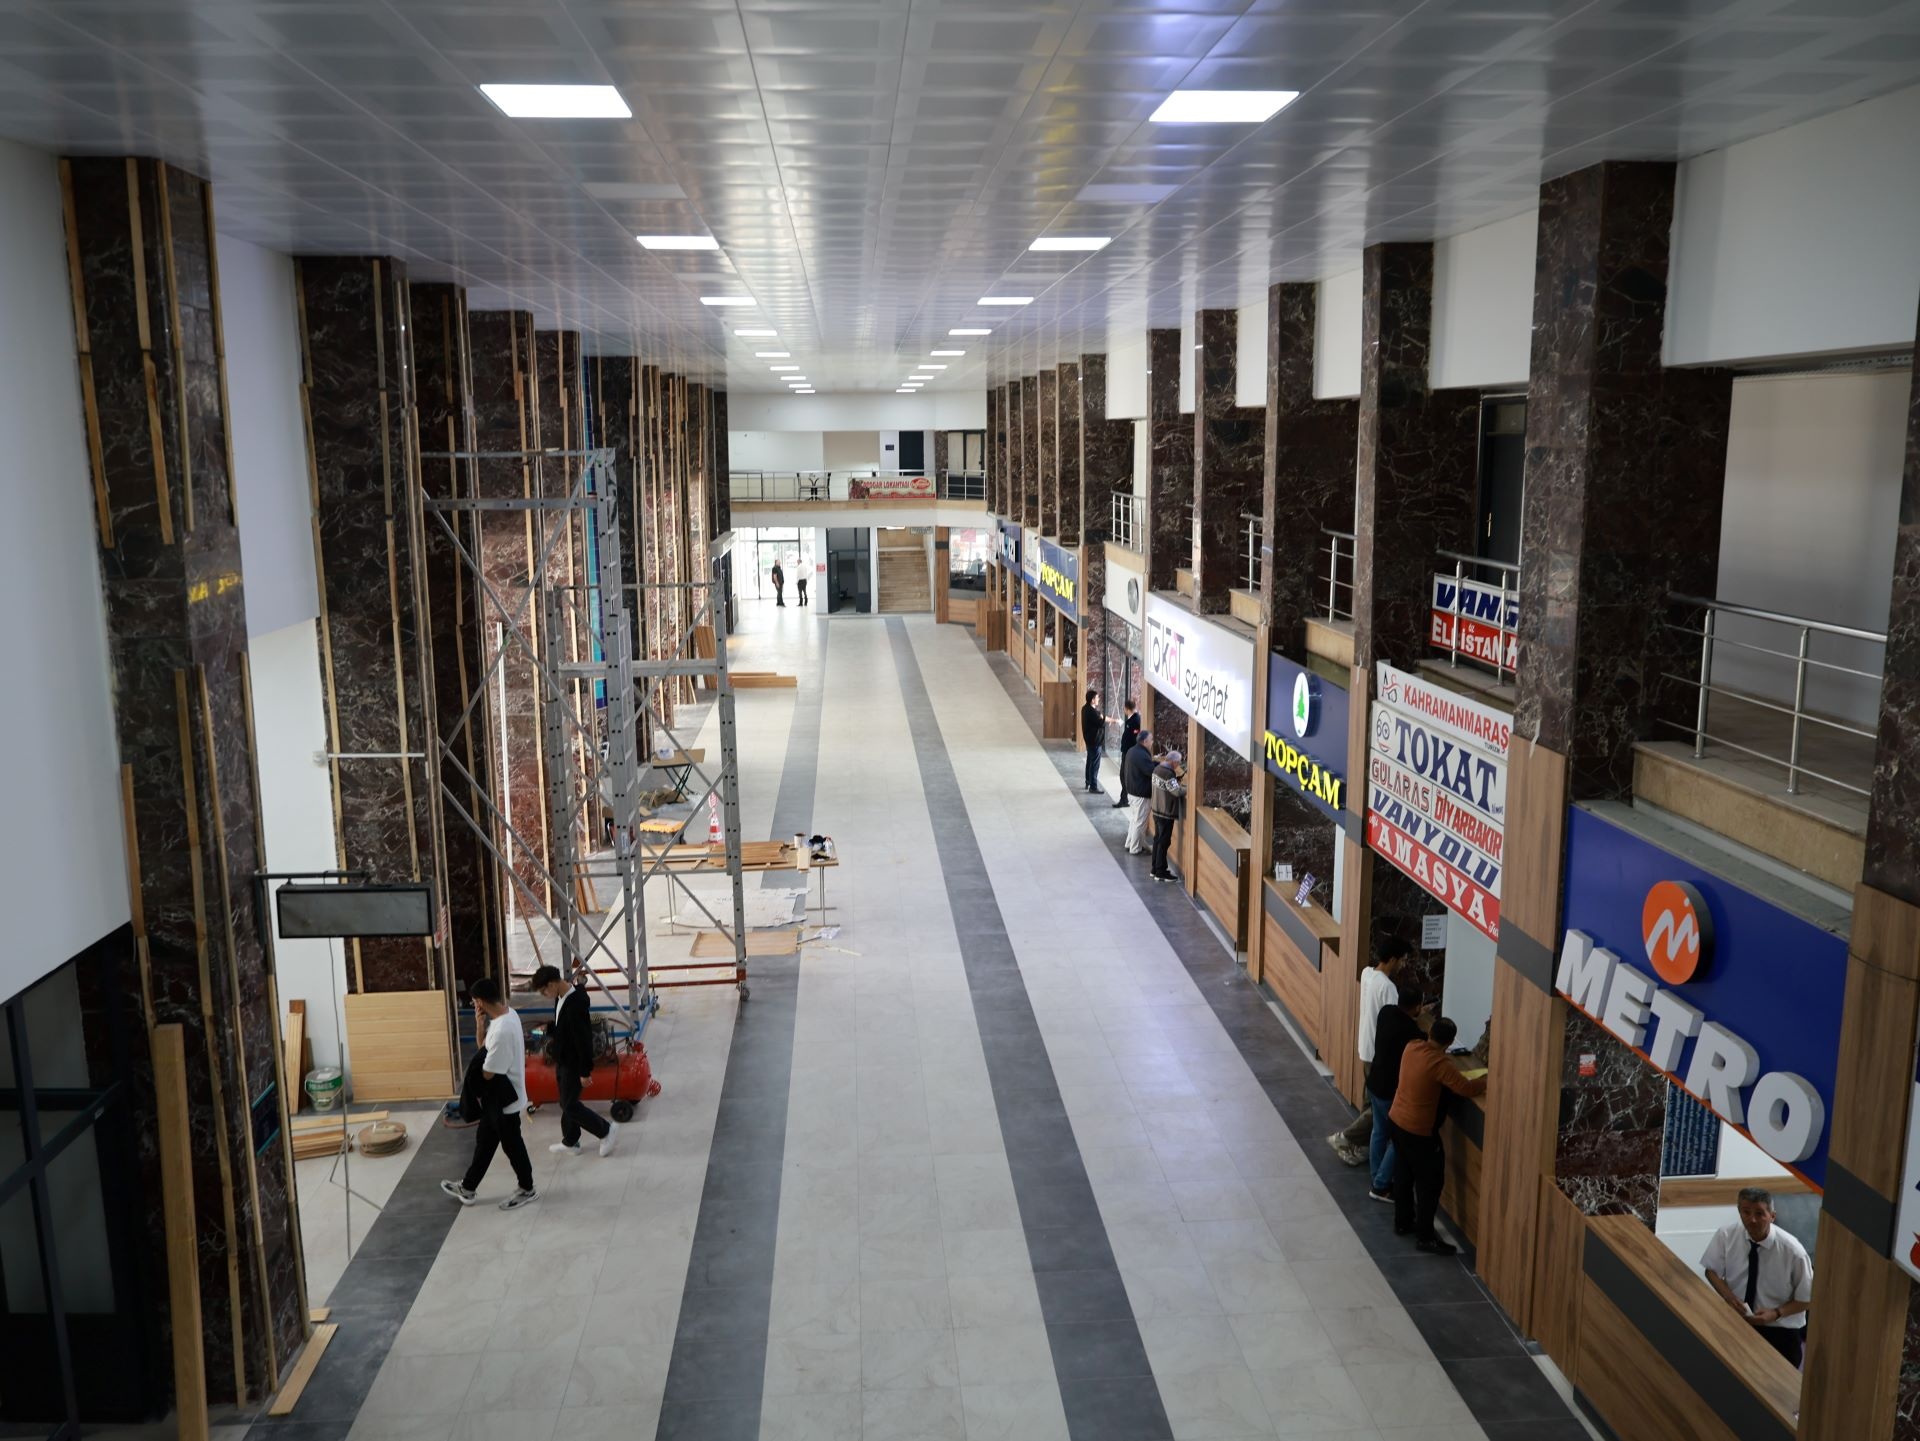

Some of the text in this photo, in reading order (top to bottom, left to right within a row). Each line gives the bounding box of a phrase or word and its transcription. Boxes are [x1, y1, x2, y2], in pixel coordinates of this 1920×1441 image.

[1041, 562, 1074, 603] TOPÇAM
[1184, 668, 1228, 725] seyahat
[1404, 684, 1510, 754] KAHRAMANMARAŞ
[1264, 730, 1341, 811] TOPÇAM
[1395, 717, 1497, 814] TOKAT
[1373, 788, 1499, 890] VANYOLU
[1434, 793, 1503, 861] DİYARBAKIR
[1377, 822, 1488, 929] AMASYA
[1555, 928, 1825, 1163] METRO
